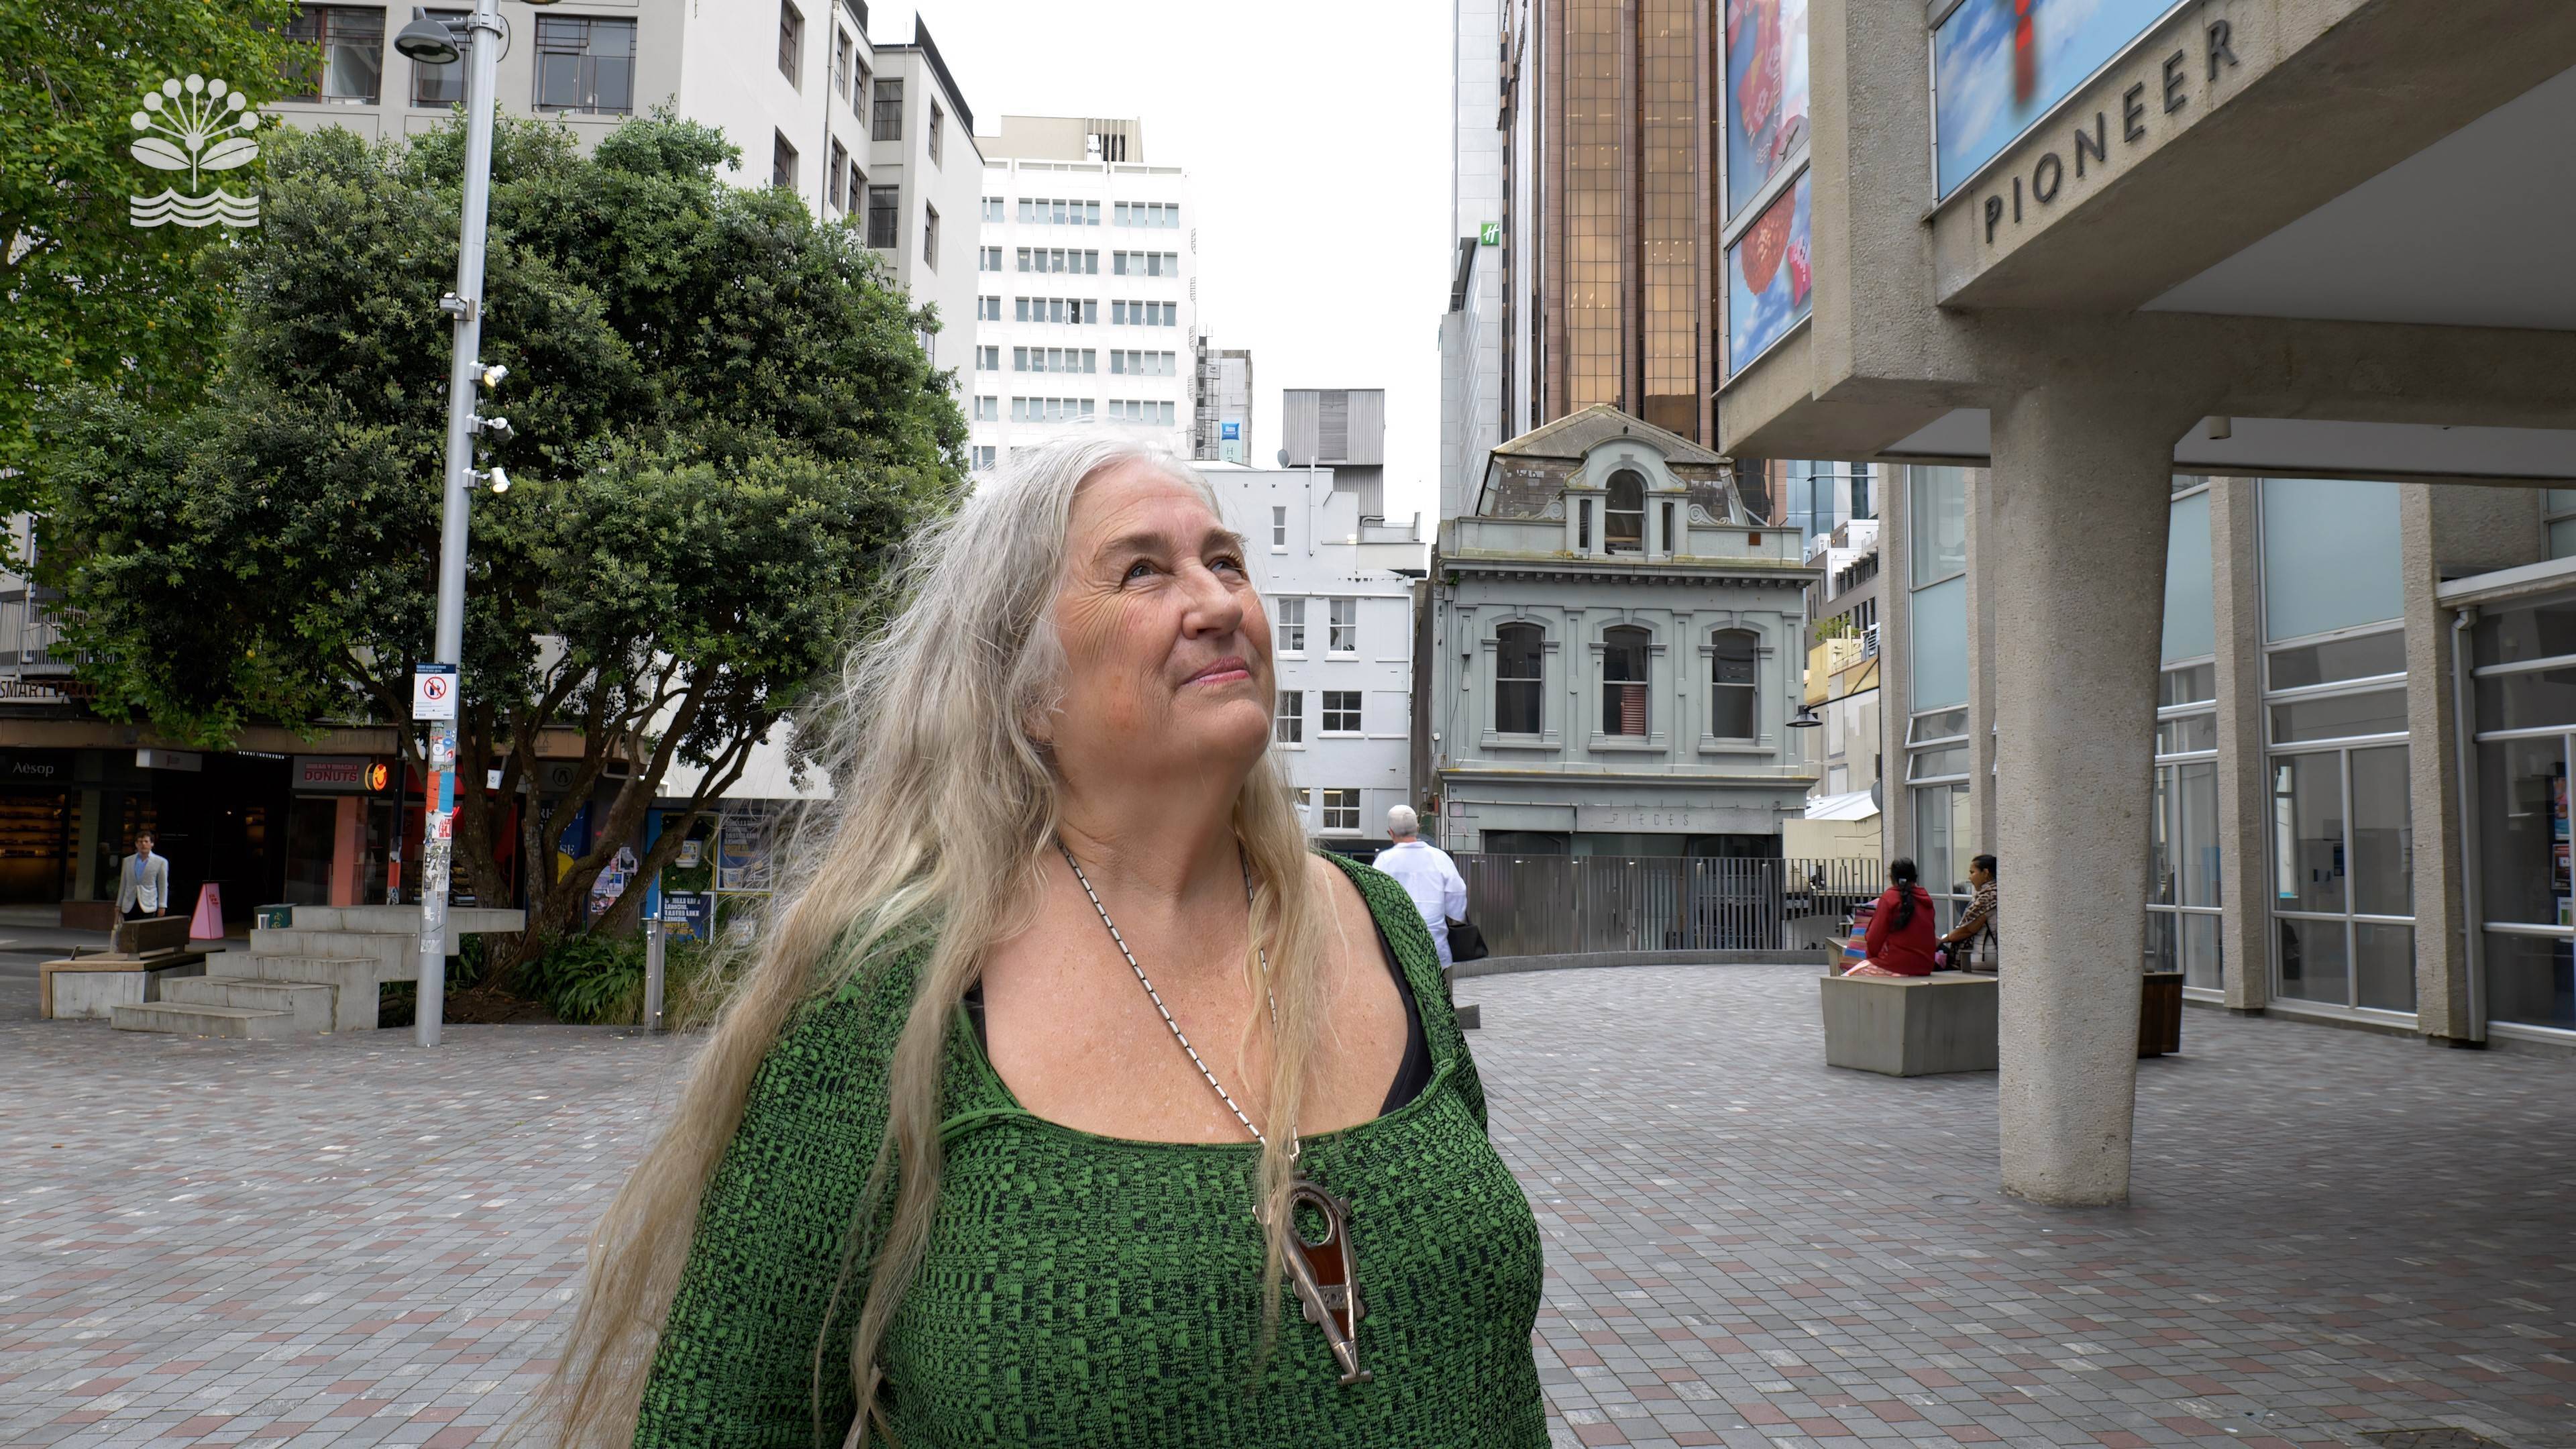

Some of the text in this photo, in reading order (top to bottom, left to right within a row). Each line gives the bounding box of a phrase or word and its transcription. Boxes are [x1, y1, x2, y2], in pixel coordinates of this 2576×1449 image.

[1984, 19, 2238, 244] PIONEER
[0, 681, 46, 698] SMART
[305, 771, 358, 782] DONUTS
